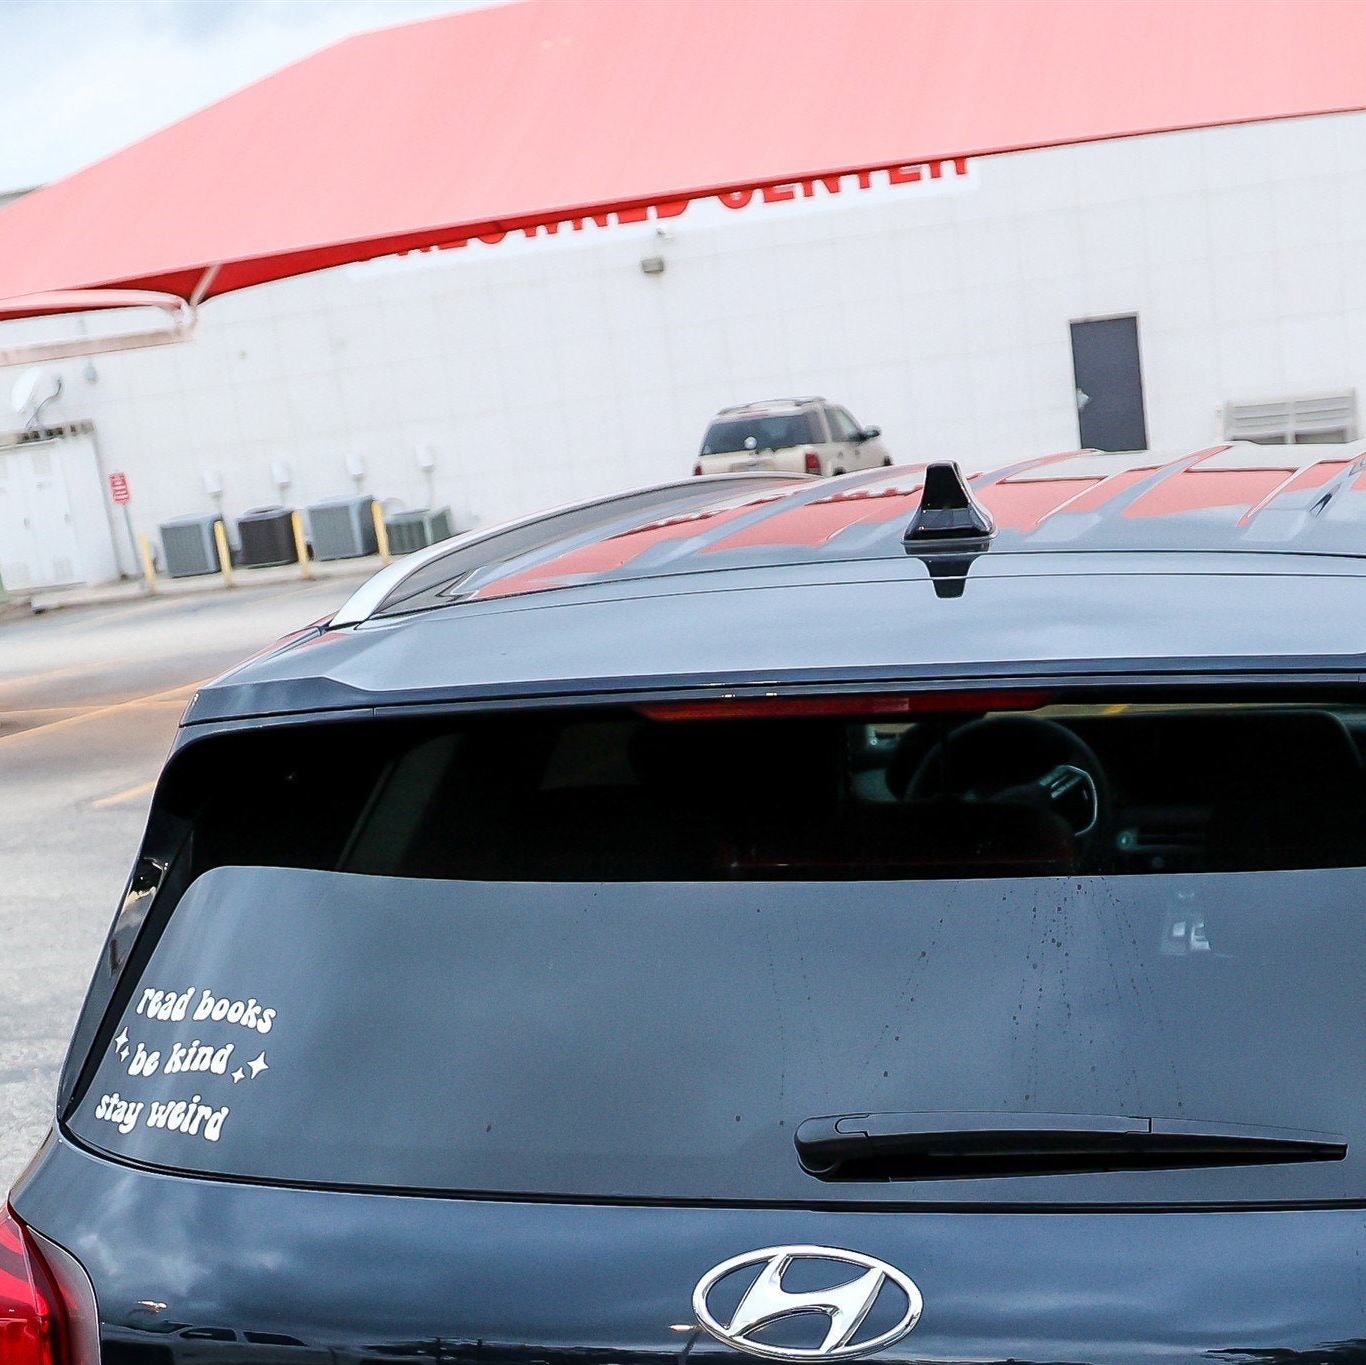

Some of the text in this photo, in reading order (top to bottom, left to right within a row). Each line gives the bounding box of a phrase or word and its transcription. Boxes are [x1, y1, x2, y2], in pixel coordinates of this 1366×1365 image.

[136, 986, 277, 1034] read books
[127, 1039, 235, 1077] be kind
[94, 1092, 231, 1142] stay weird
